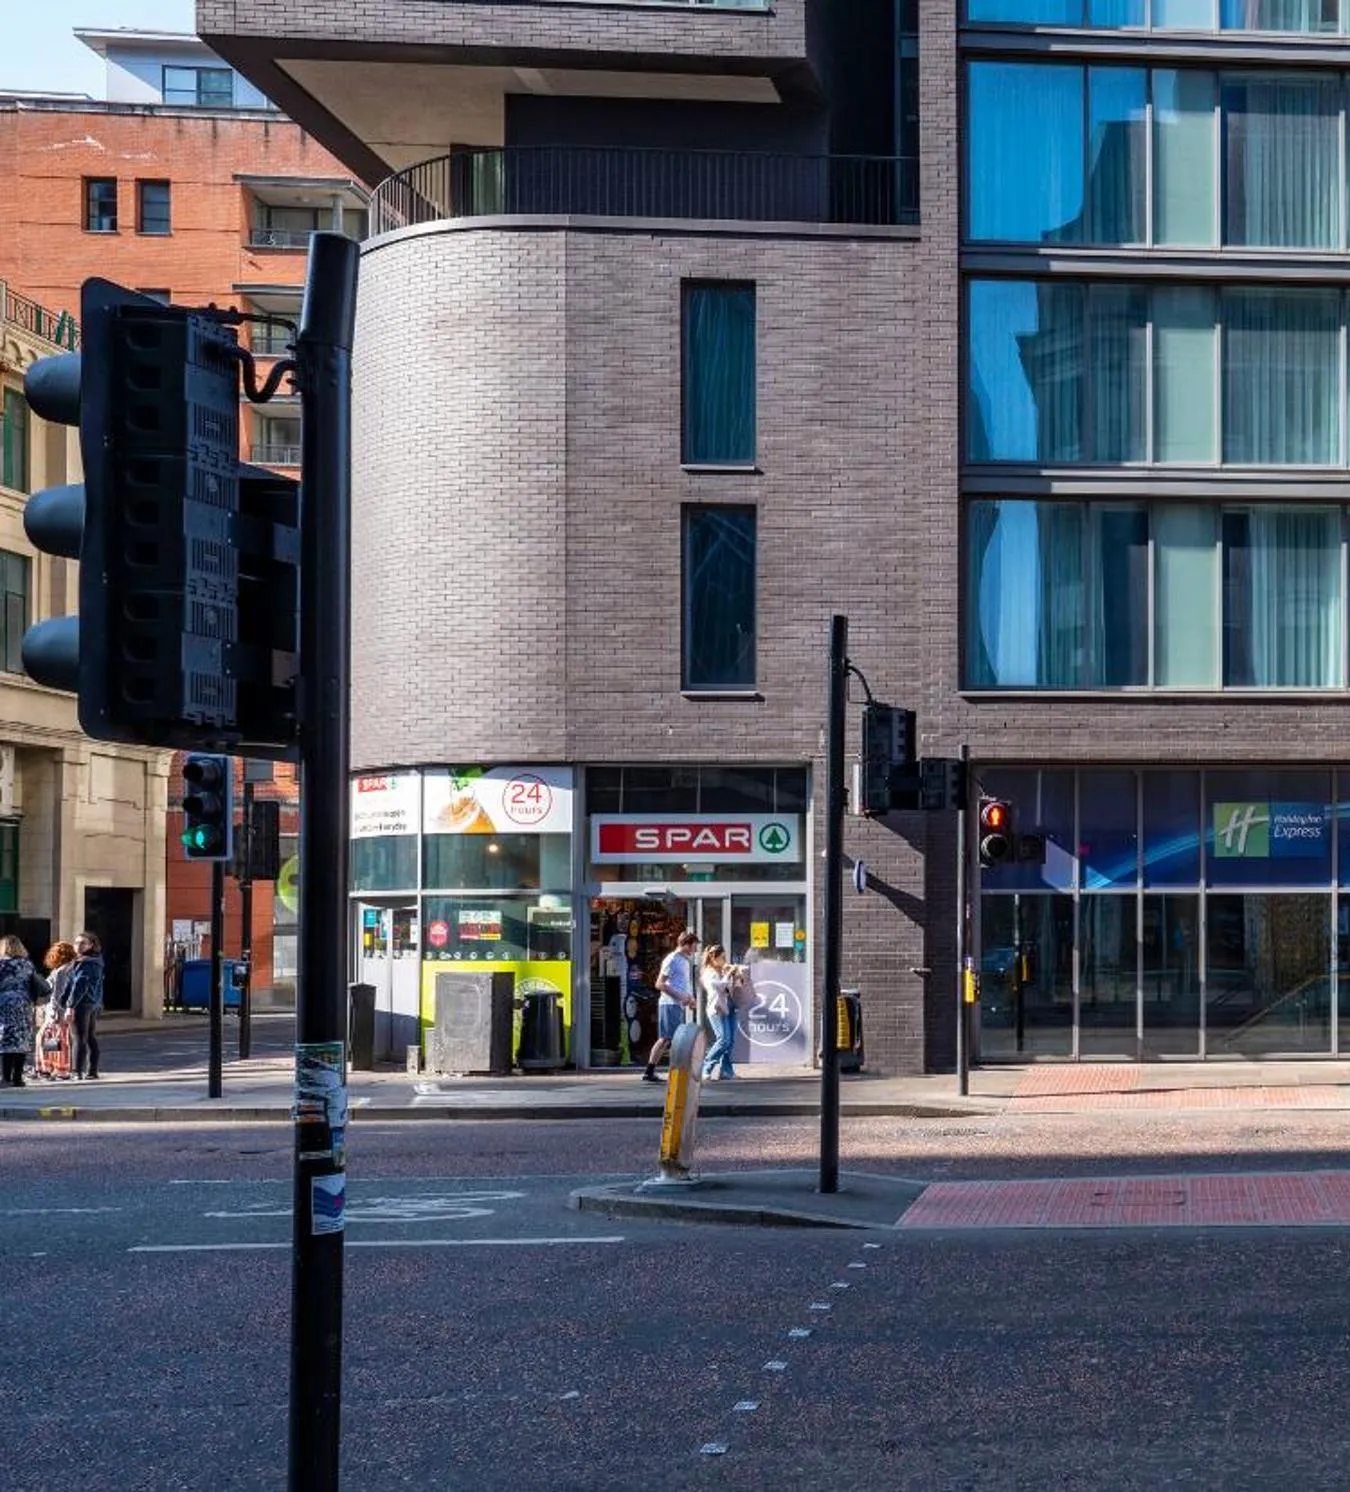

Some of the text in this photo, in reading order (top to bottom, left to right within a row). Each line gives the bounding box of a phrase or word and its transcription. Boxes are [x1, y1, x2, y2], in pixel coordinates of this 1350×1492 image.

[511, 783, 543, 804] 24
[634, 828, 750, 849] SPAR
[1273, 825, 1322, 838] Express
[747, 992, 790, 1019] 24
